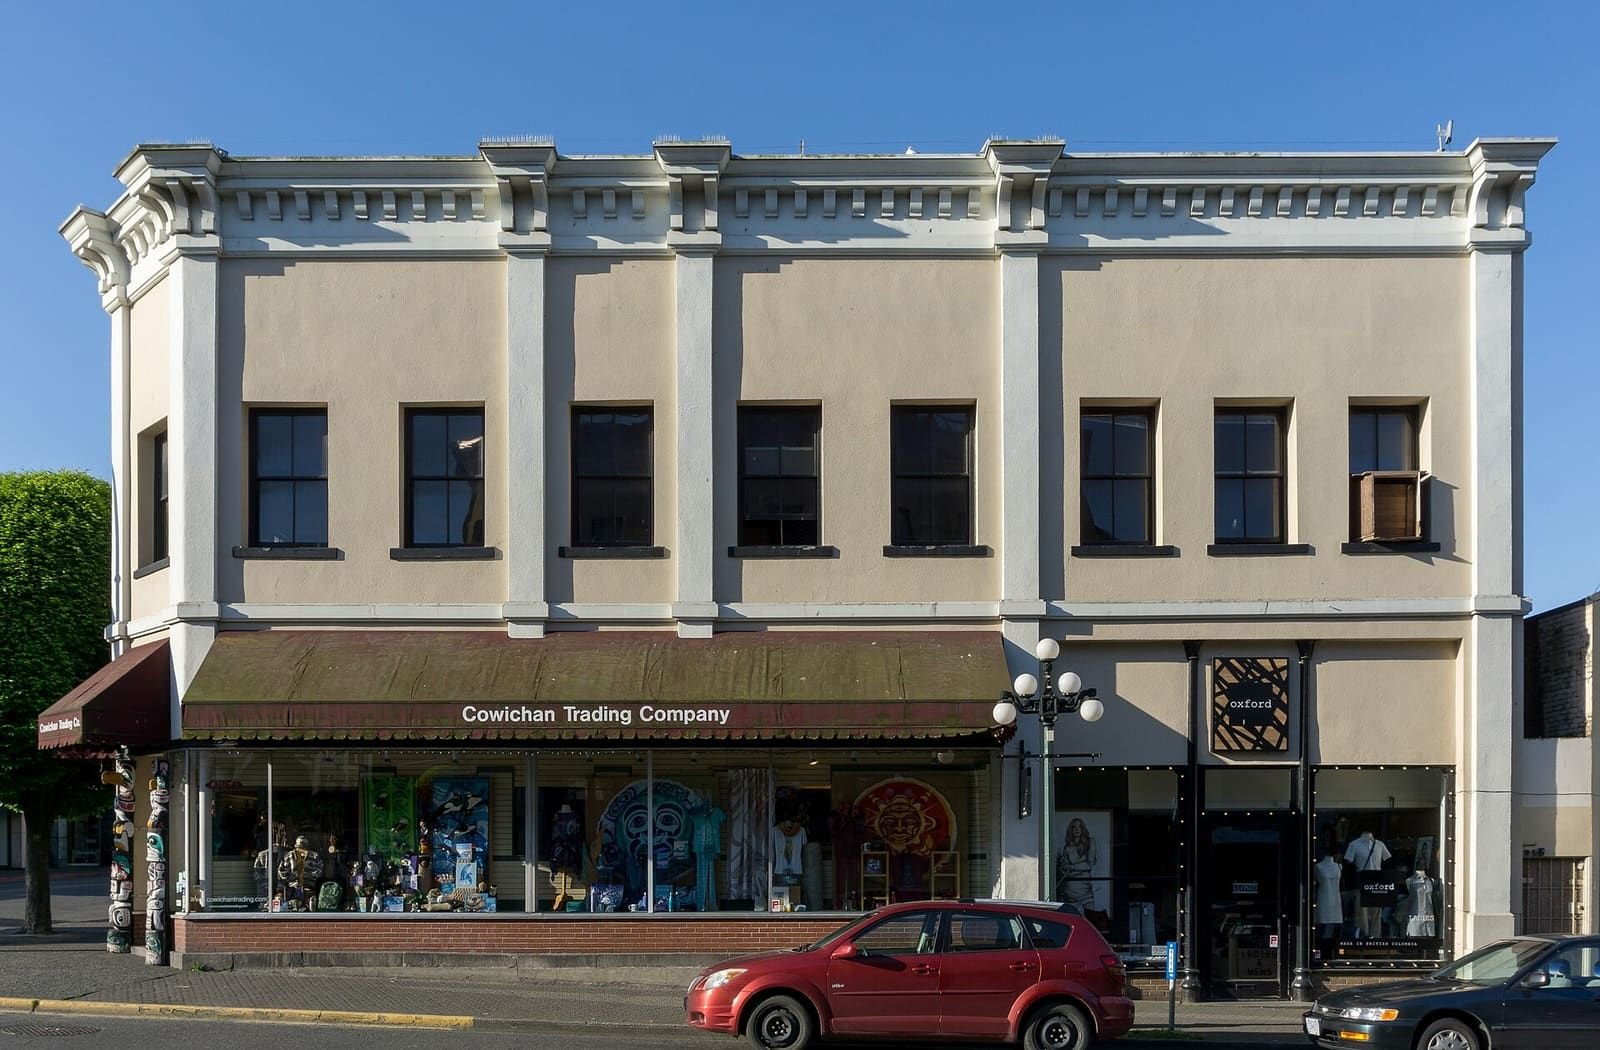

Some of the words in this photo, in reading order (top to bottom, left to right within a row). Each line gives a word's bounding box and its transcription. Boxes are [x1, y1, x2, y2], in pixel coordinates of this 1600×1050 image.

[1230, 699, 1272, 708] oxford
[462, 706, 555, 722] Cowichan
[563, 706, 632, 725] Trading
[639, 706, 730, 725] Company
[40, 721, 58, 734] Cowichan
[59, 719, 73, 730] Trading
